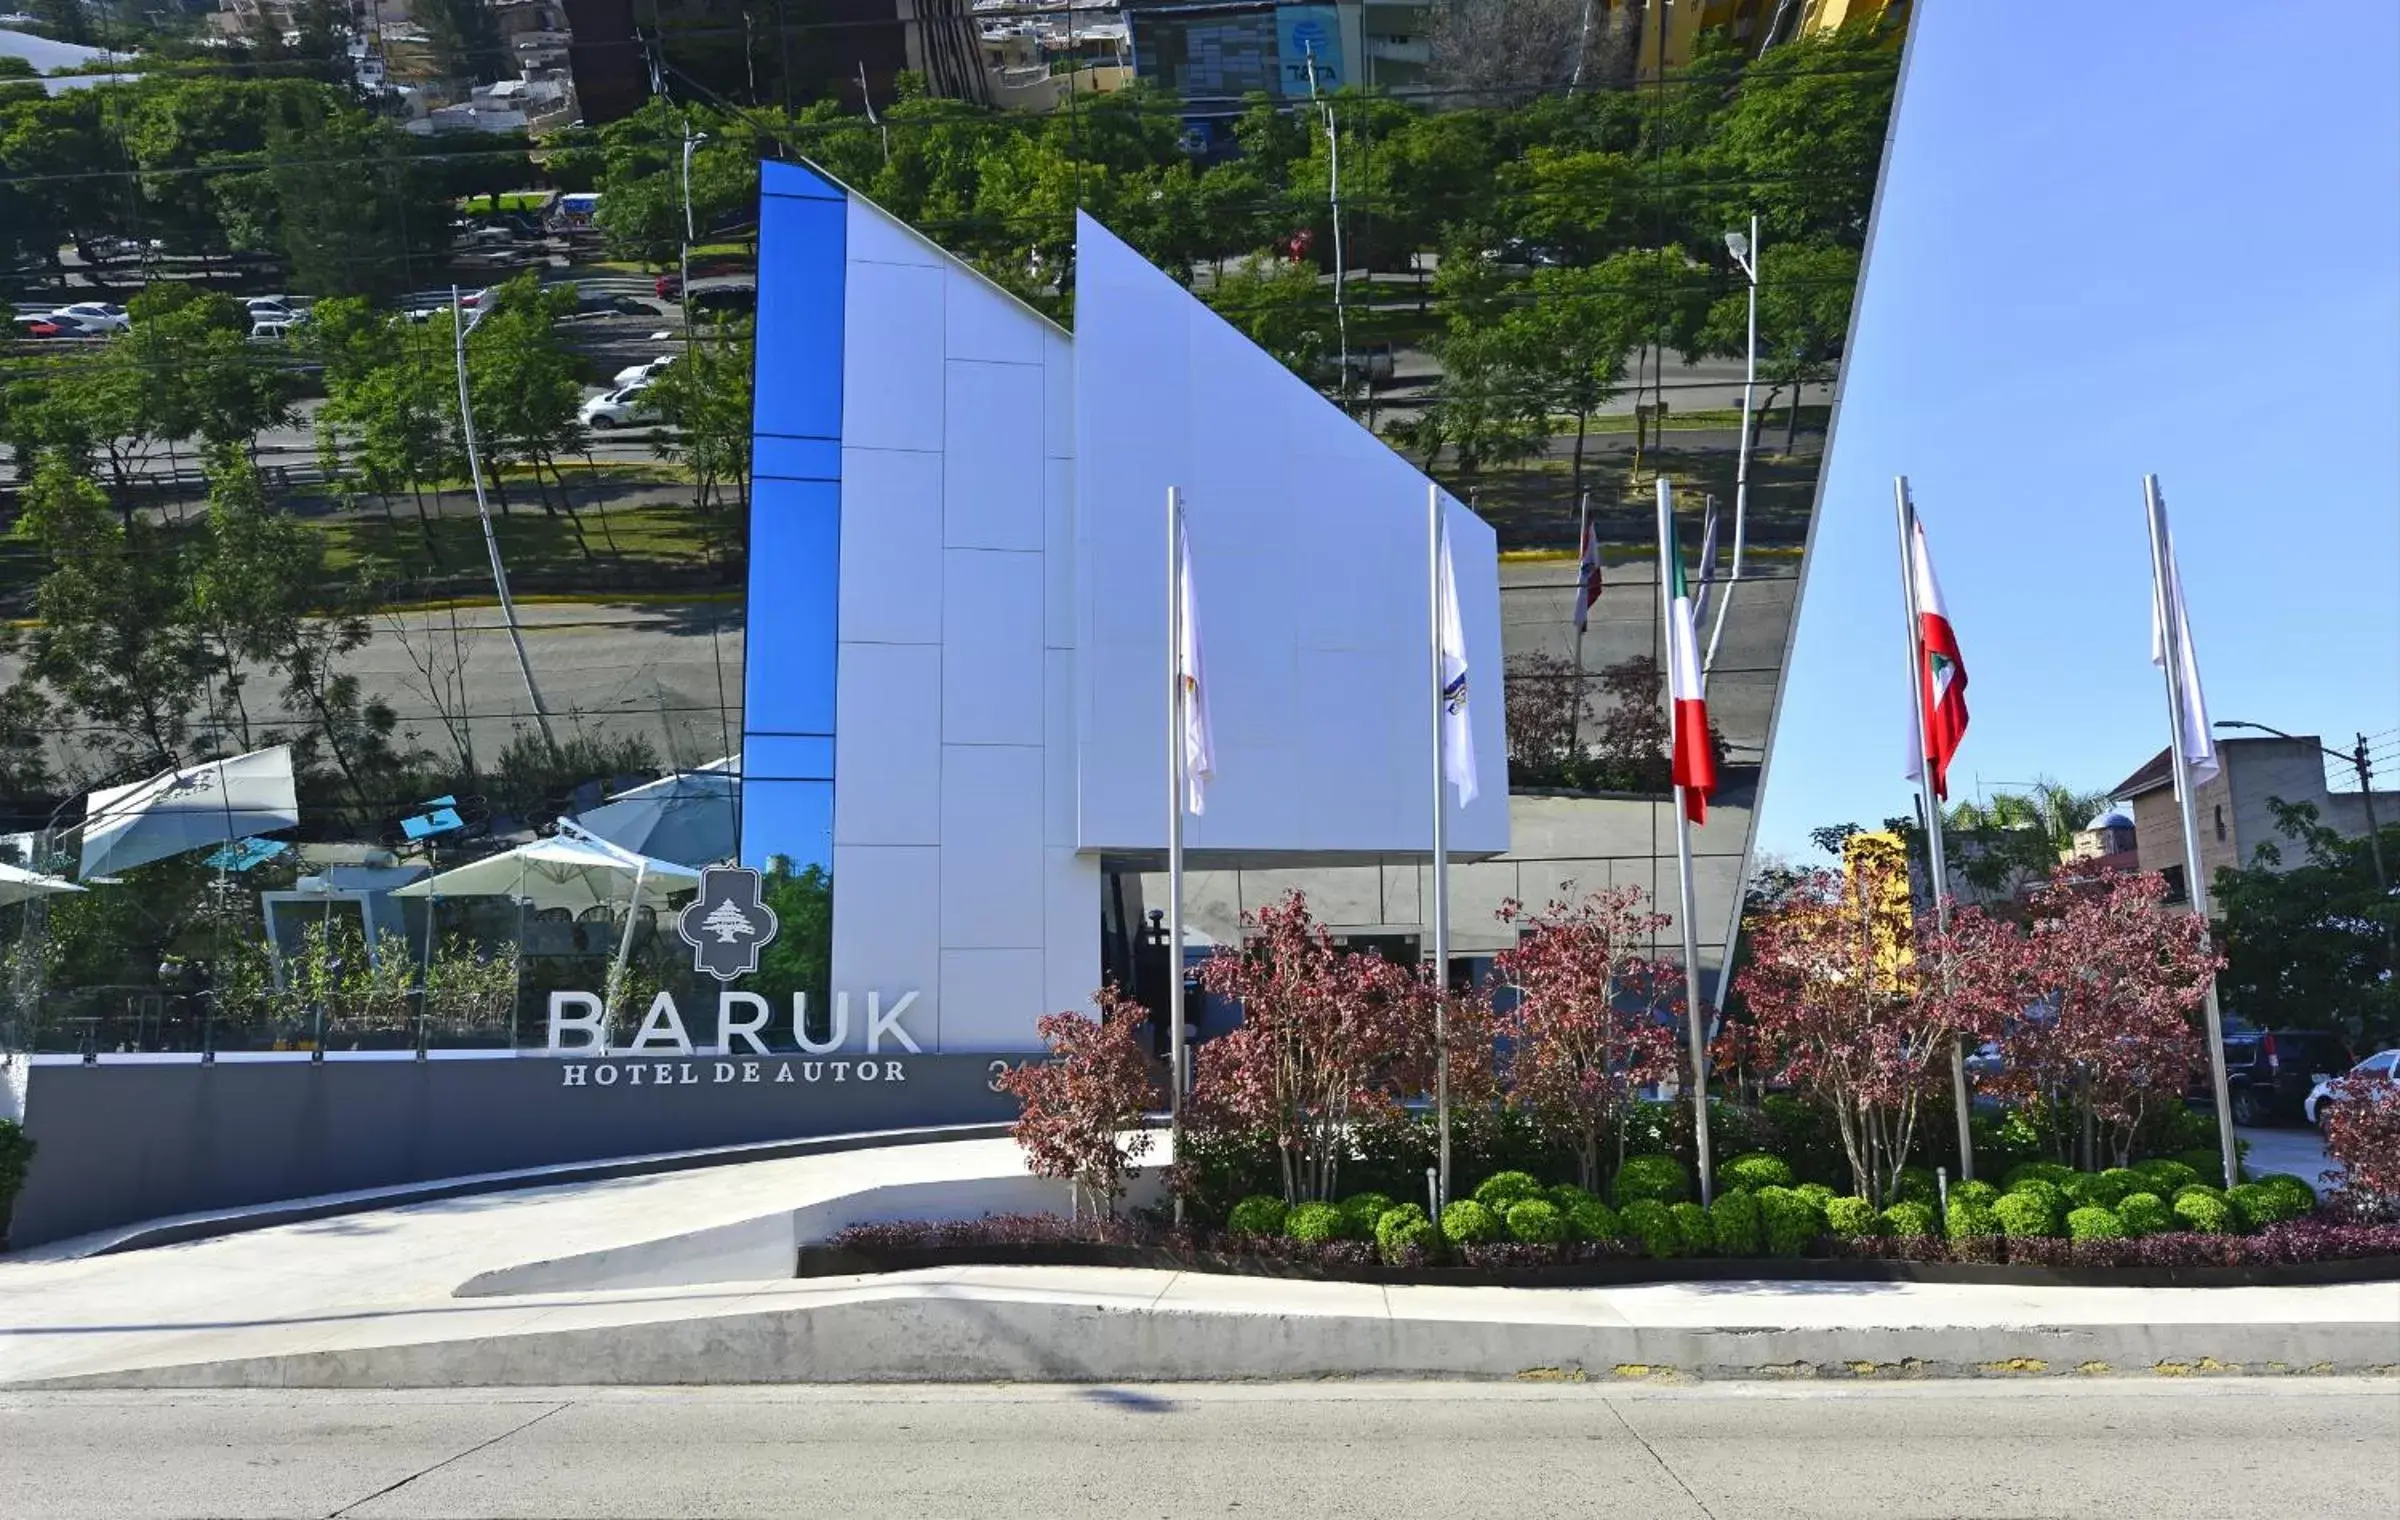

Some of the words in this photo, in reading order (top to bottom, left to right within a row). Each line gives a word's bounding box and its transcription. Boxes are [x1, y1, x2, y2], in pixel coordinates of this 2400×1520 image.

[548, 990, 922, 1055] BARUK
[562, 1063, 699, 1086] HOTEL
[713, 1062, 760, 1083] DE
[774, 1061, 905, 1083] AUTOR
